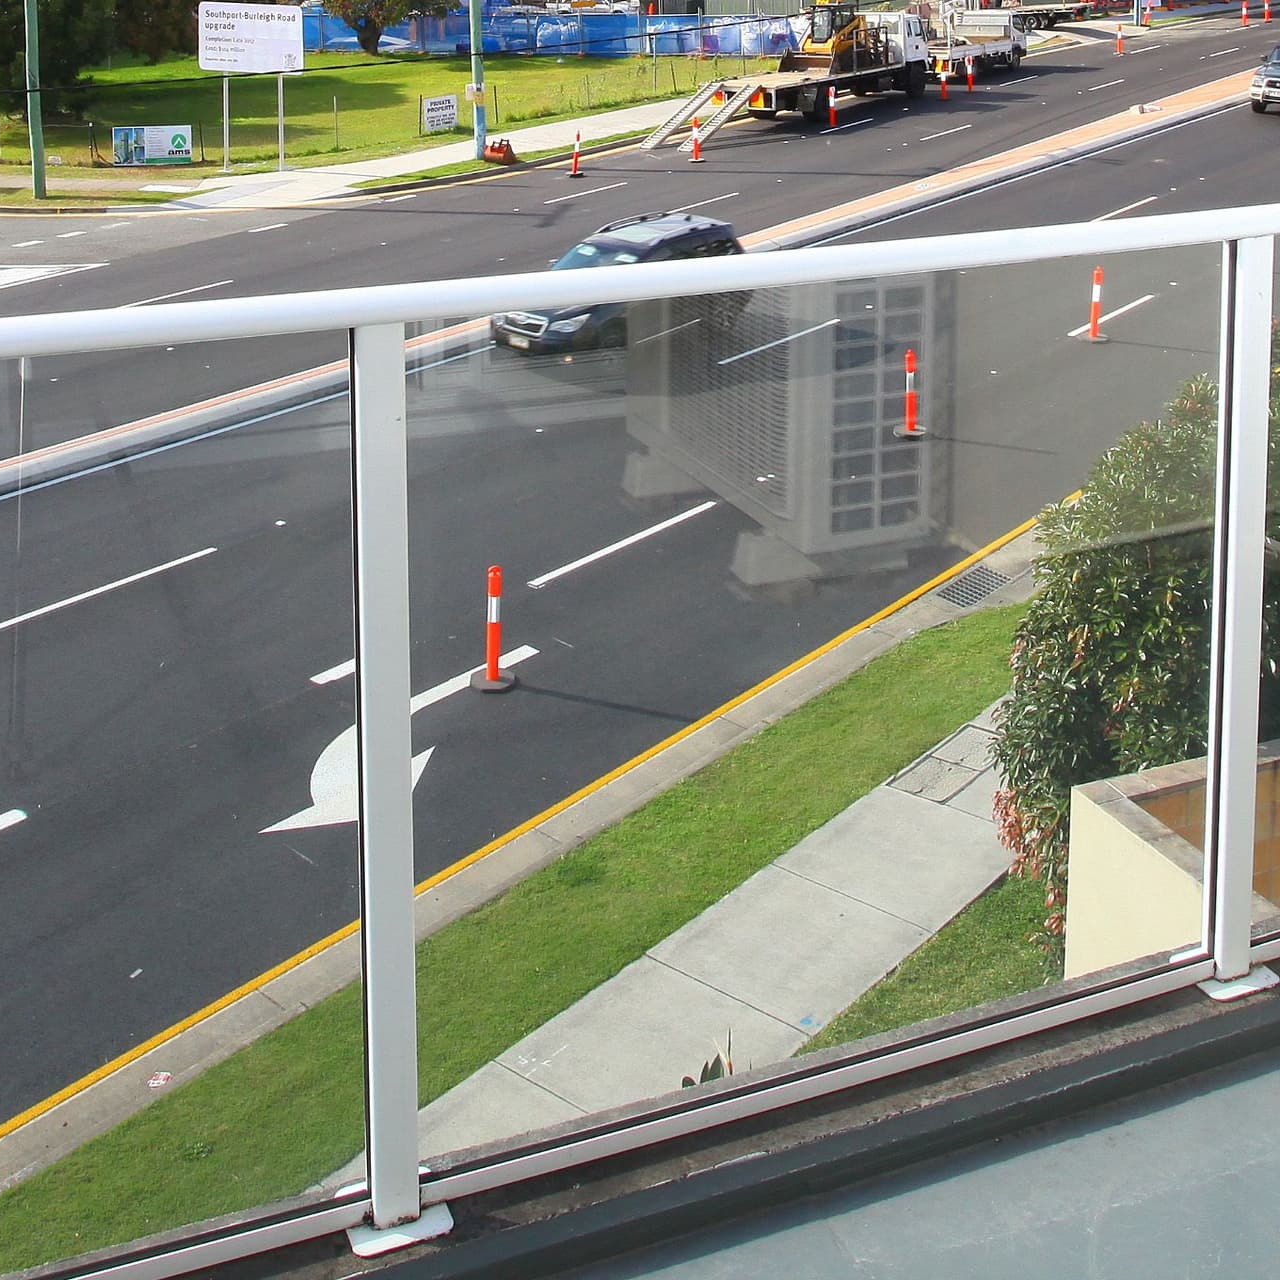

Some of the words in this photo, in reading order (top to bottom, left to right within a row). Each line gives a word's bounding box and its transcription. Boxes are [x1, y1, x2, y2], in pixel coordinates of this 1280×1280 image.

[205, 10, 275, 22] Southport-Burleigh
[277, 13, 296, 22] Road
[205, 22, 236, 30] upgrade
[430, 99, 451, 107] PRIVATE
[427, 104, 455, 113] PROPERTY
